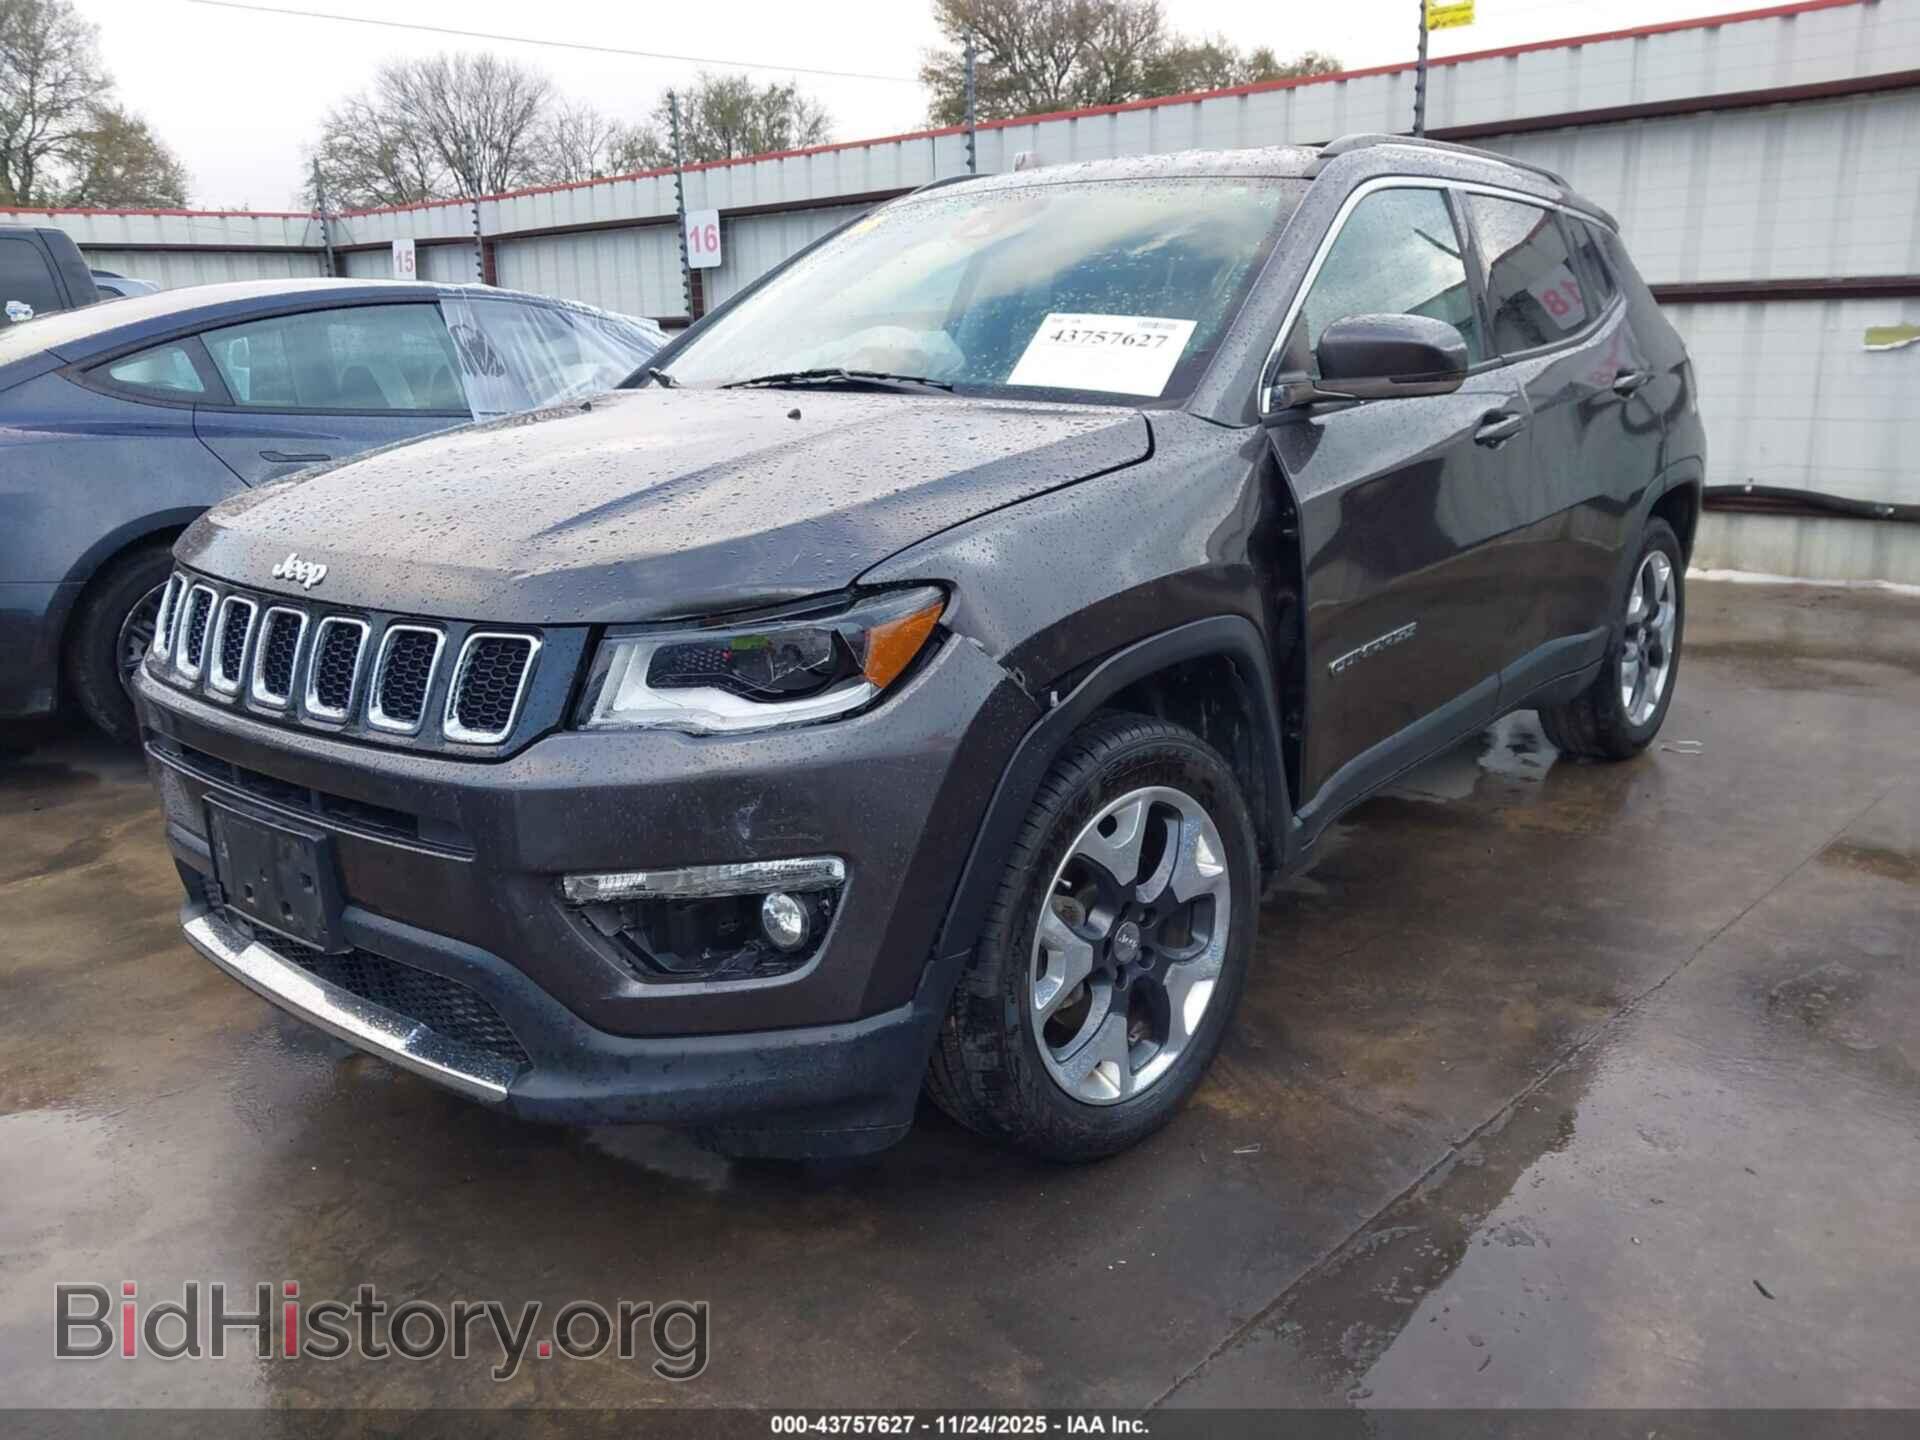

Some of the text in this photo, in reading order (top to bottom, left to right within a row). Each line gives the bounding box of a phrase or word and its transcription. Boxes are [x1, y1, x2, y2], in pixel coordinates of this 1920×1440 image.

[690, 224, 718, 253] 16
[395, 250, 414, 273] 15
[1049, 329, 1169, 349] 43757627
[271, 552, 328, 590] Jeep
